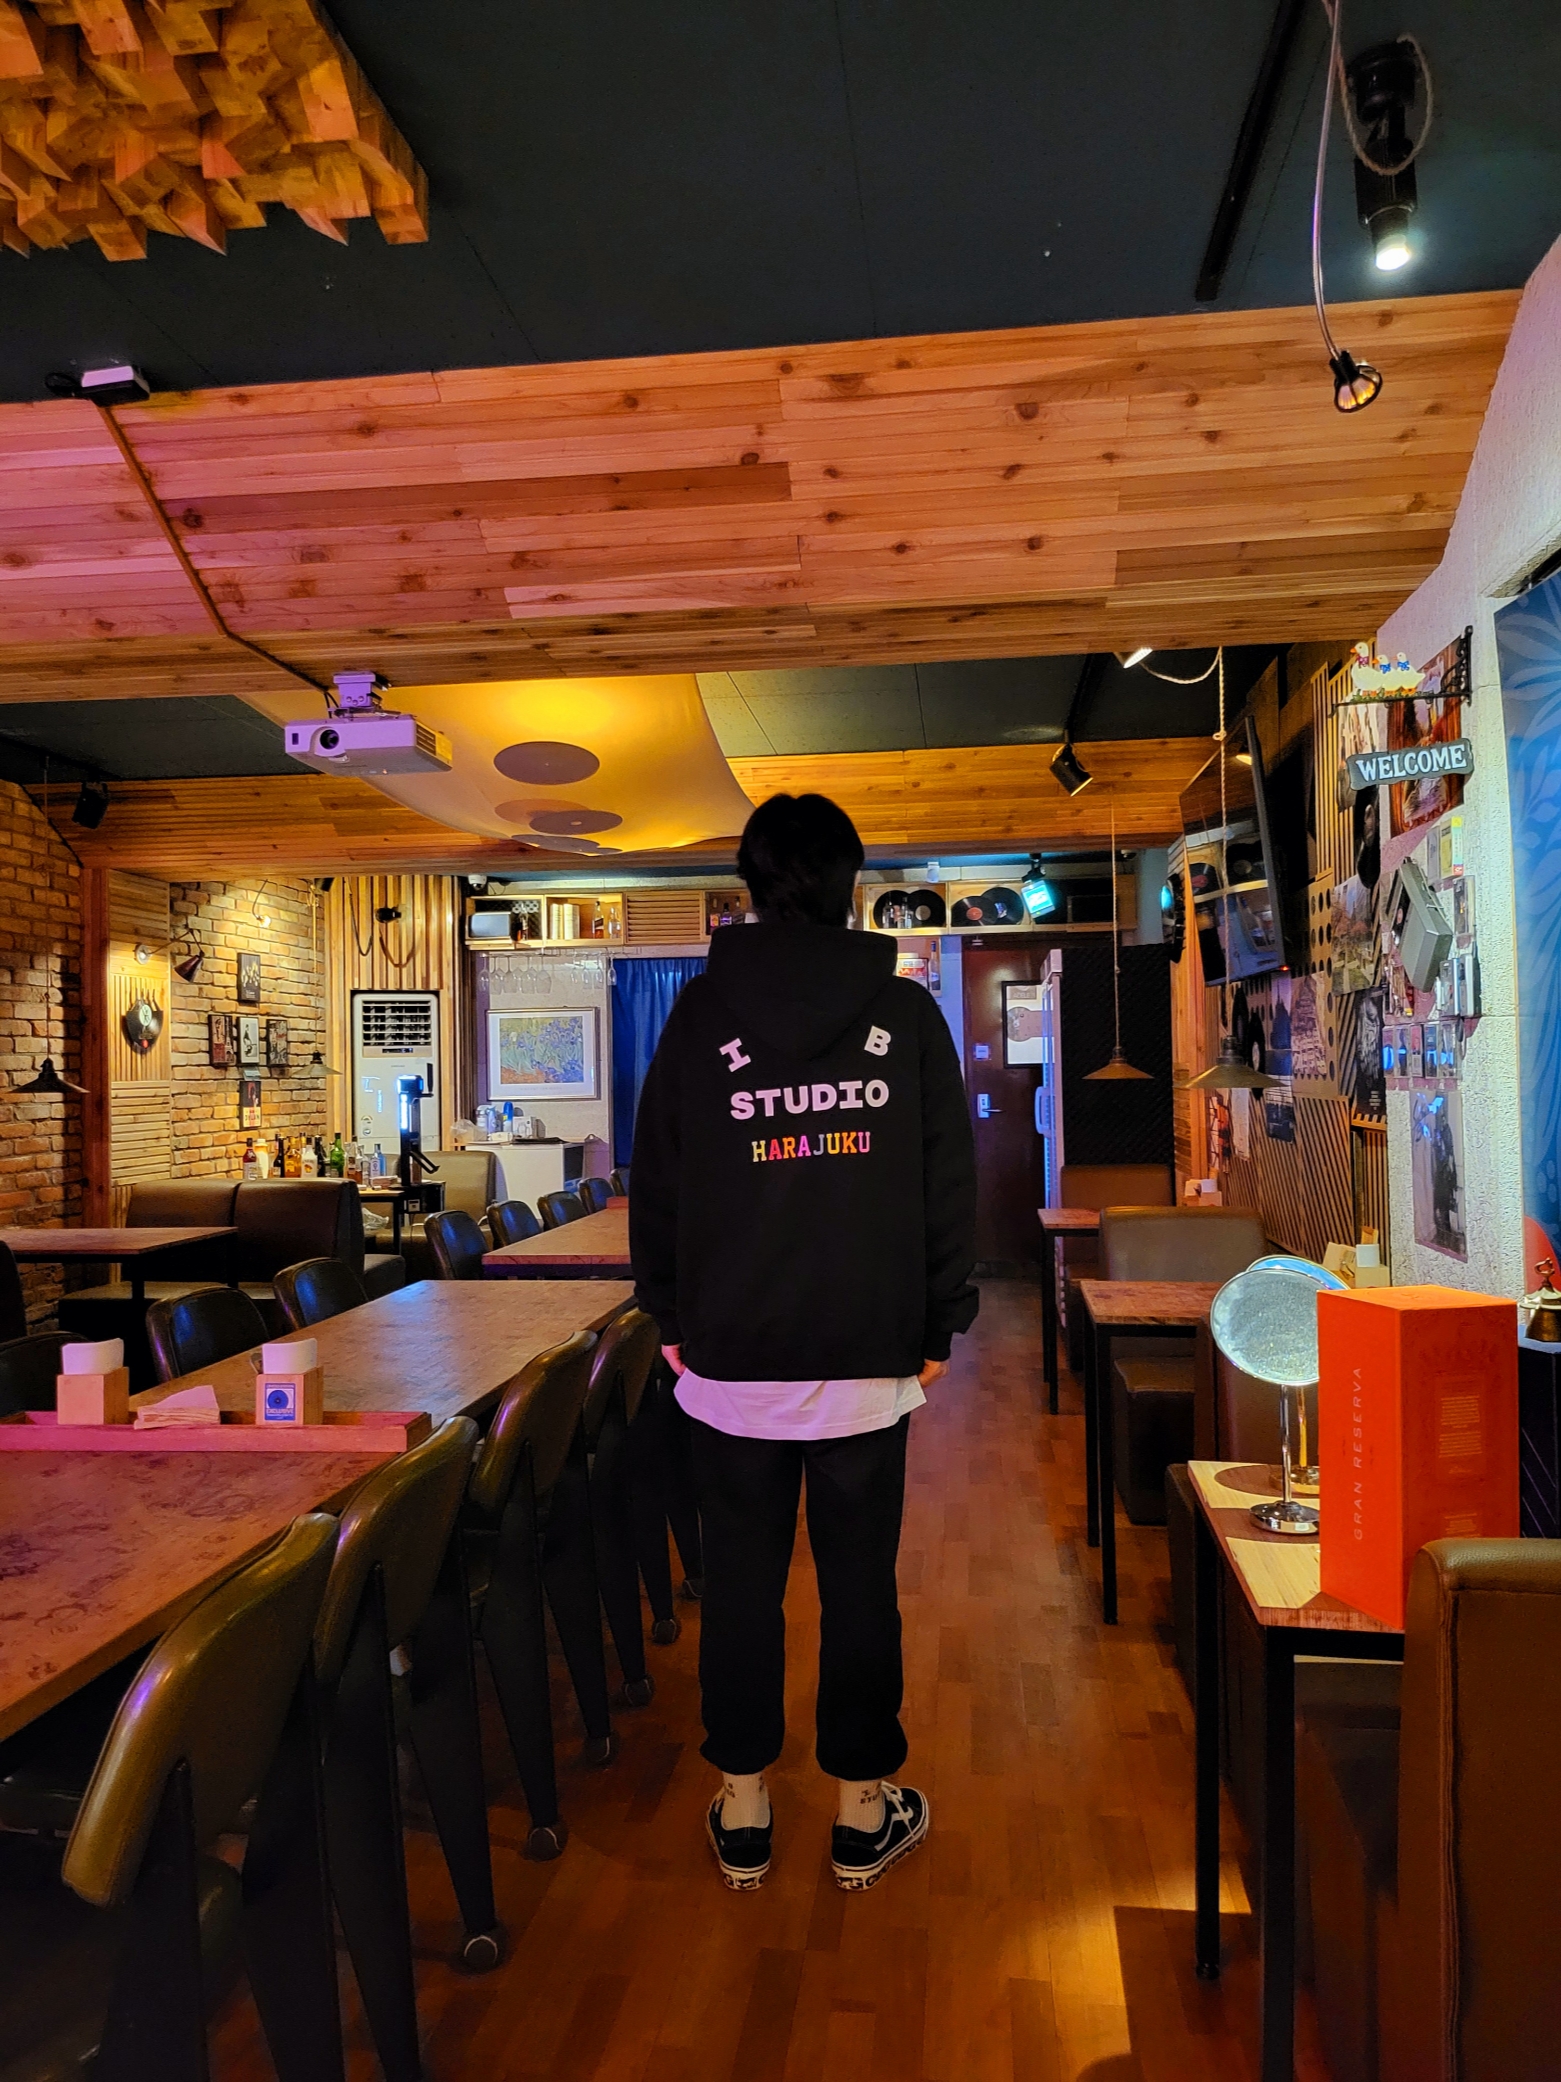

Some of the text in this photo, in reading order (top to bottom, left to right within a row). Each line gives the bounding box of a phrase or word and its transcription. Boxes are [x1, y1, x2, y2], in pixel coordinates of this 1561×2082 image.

[1356, 743, 1467, 782] WELCOME
[718, 1025, 892, 1073] I B
[730, 1079, 890, 1120] STUDIO
[751, 1131, 871, 1163] HARAJUKU
[1353, 1367, 1363, 1541] GRAN RESERVA
